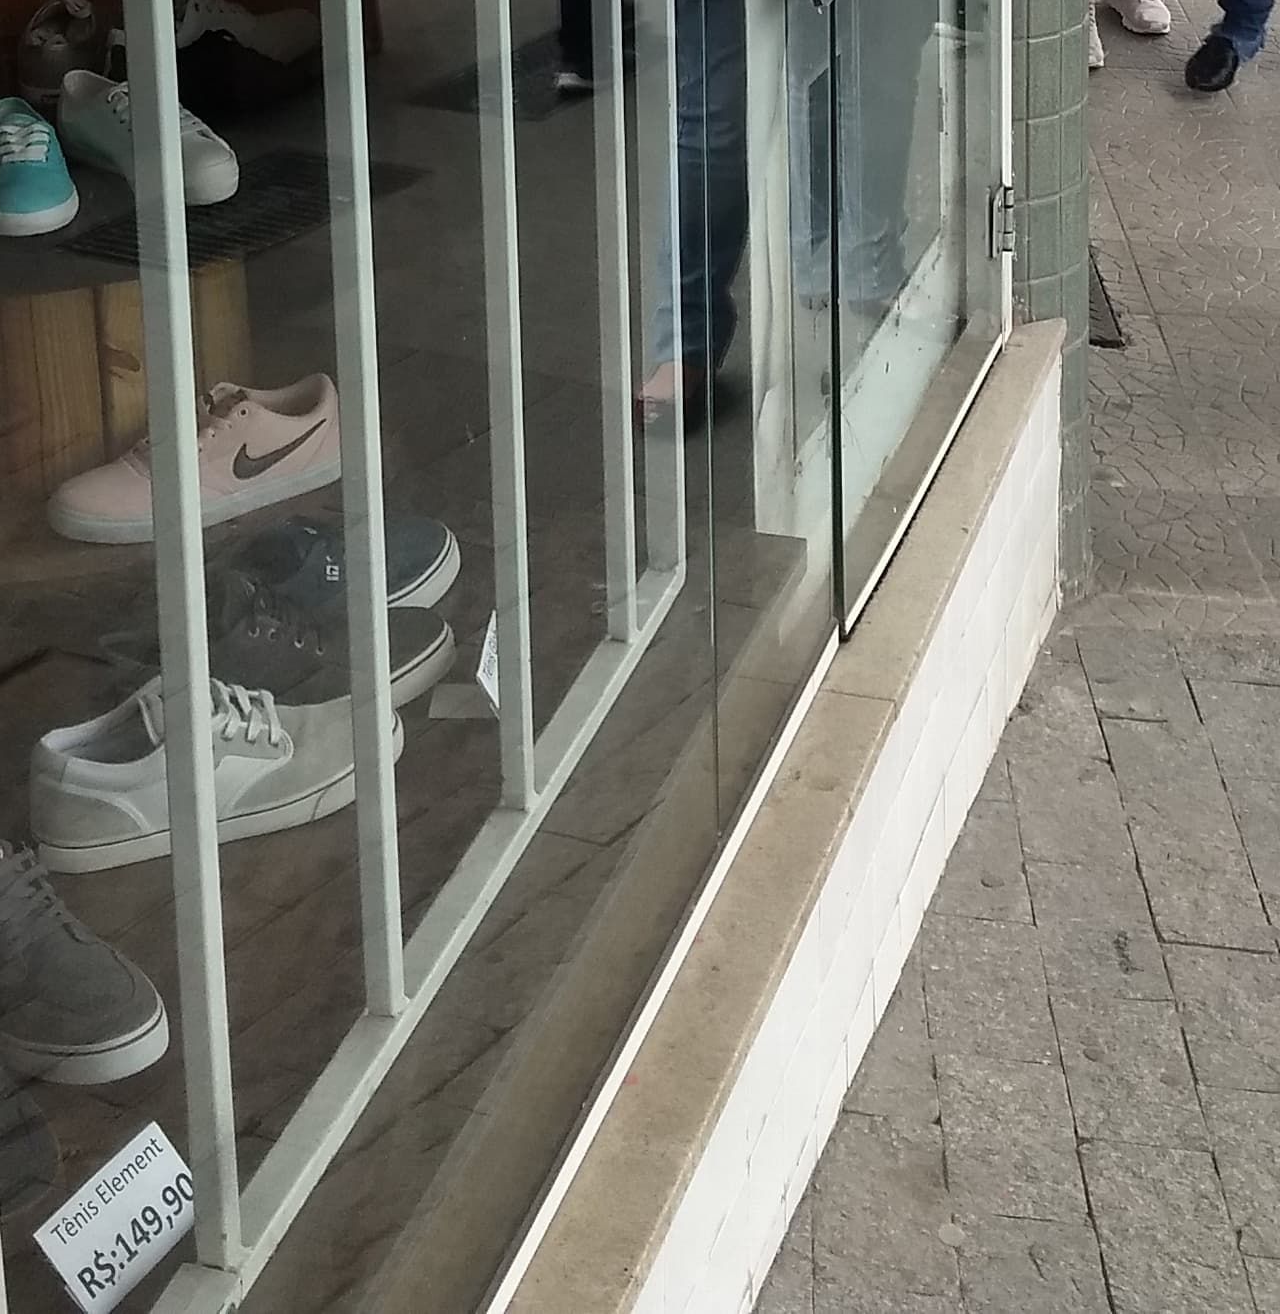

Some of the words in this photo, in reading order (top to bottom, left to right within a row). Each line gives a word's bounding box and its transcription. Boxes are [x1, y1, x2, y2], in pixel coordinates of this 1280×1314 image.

[50, 1200, 99, 1245] Tênis
[95, 1138, 164, 1205] Element
[77, 1173, 194, 1299] R$:149,90
